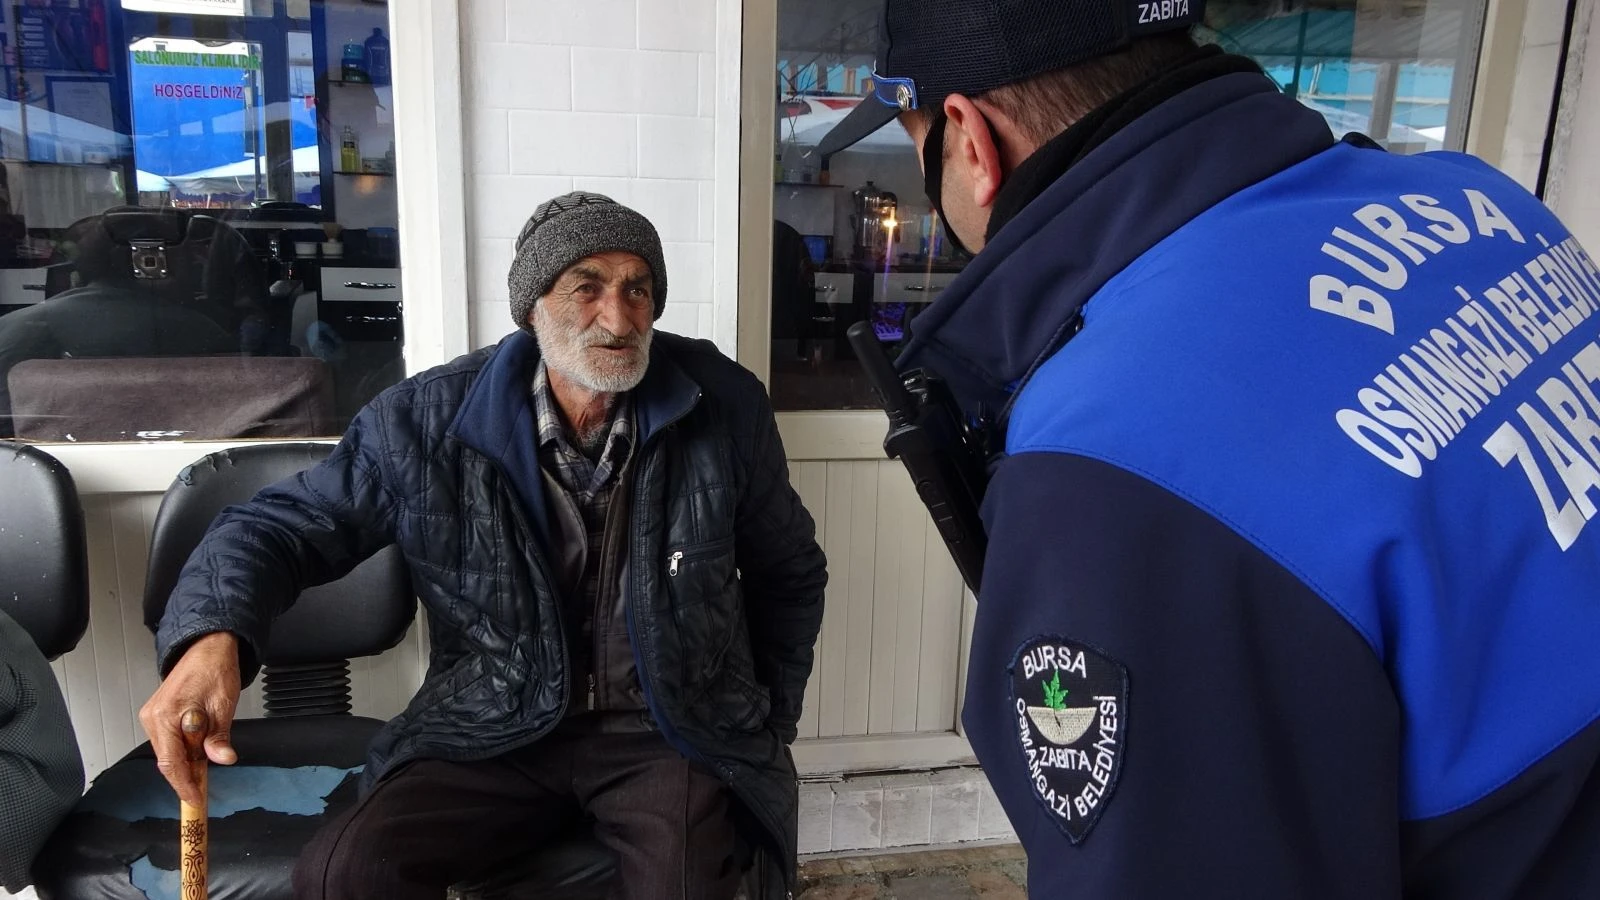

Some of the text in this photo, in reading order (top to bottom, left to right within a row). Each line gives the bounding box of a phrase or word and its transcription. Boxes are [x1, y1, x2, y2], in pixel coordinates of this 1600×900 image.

[1138, 0, 1189, 24] ZABITA
[1309, 188, 1526, 335] BURSA
[1335, 232, 1600, 478] OSMANGAZİ BELEDİYE
[1022, 645, 1087, 680] BURSA
[1016, 695, 1117, 821] OSMANGAZİ BELEDİYESİ
[1039, 746, 1092, 772] ZABITA
